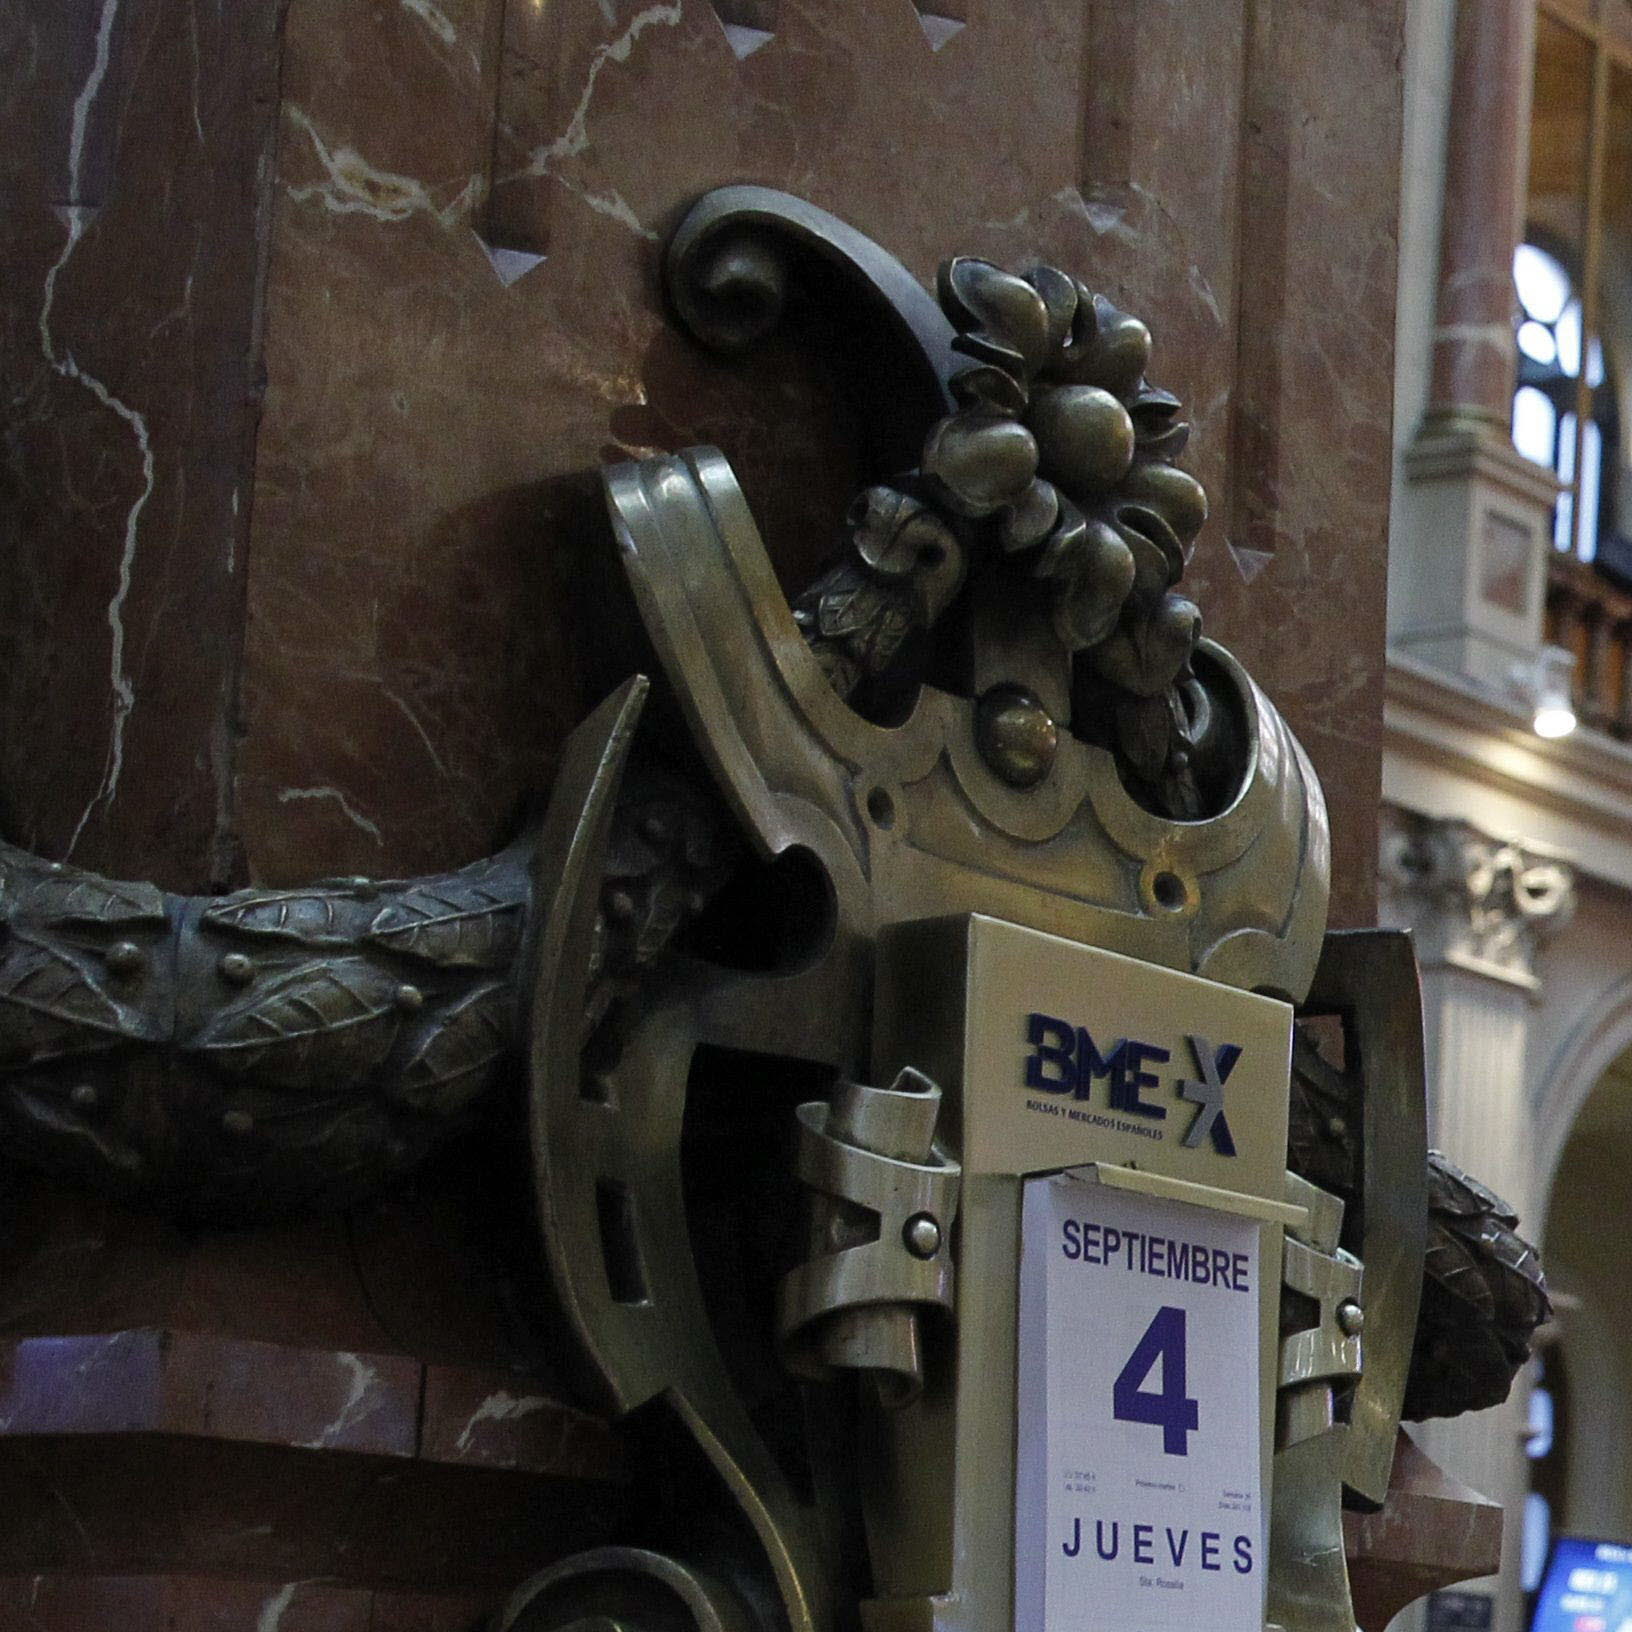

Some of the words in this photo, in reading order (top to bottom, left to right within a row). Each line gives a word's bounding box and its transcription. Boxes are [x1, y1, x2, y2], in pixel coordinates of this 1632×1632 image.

[1061, 1109, 1067, 1119] Y
[1068, 1110, 1115, 1130] MERCADOS
[1061, 1219, 1250, 1294] SEPTIEMBRE
[1113, 1305, 1199, 1457] 4
[1062, 1518, 1253, 1574] JUEVES
